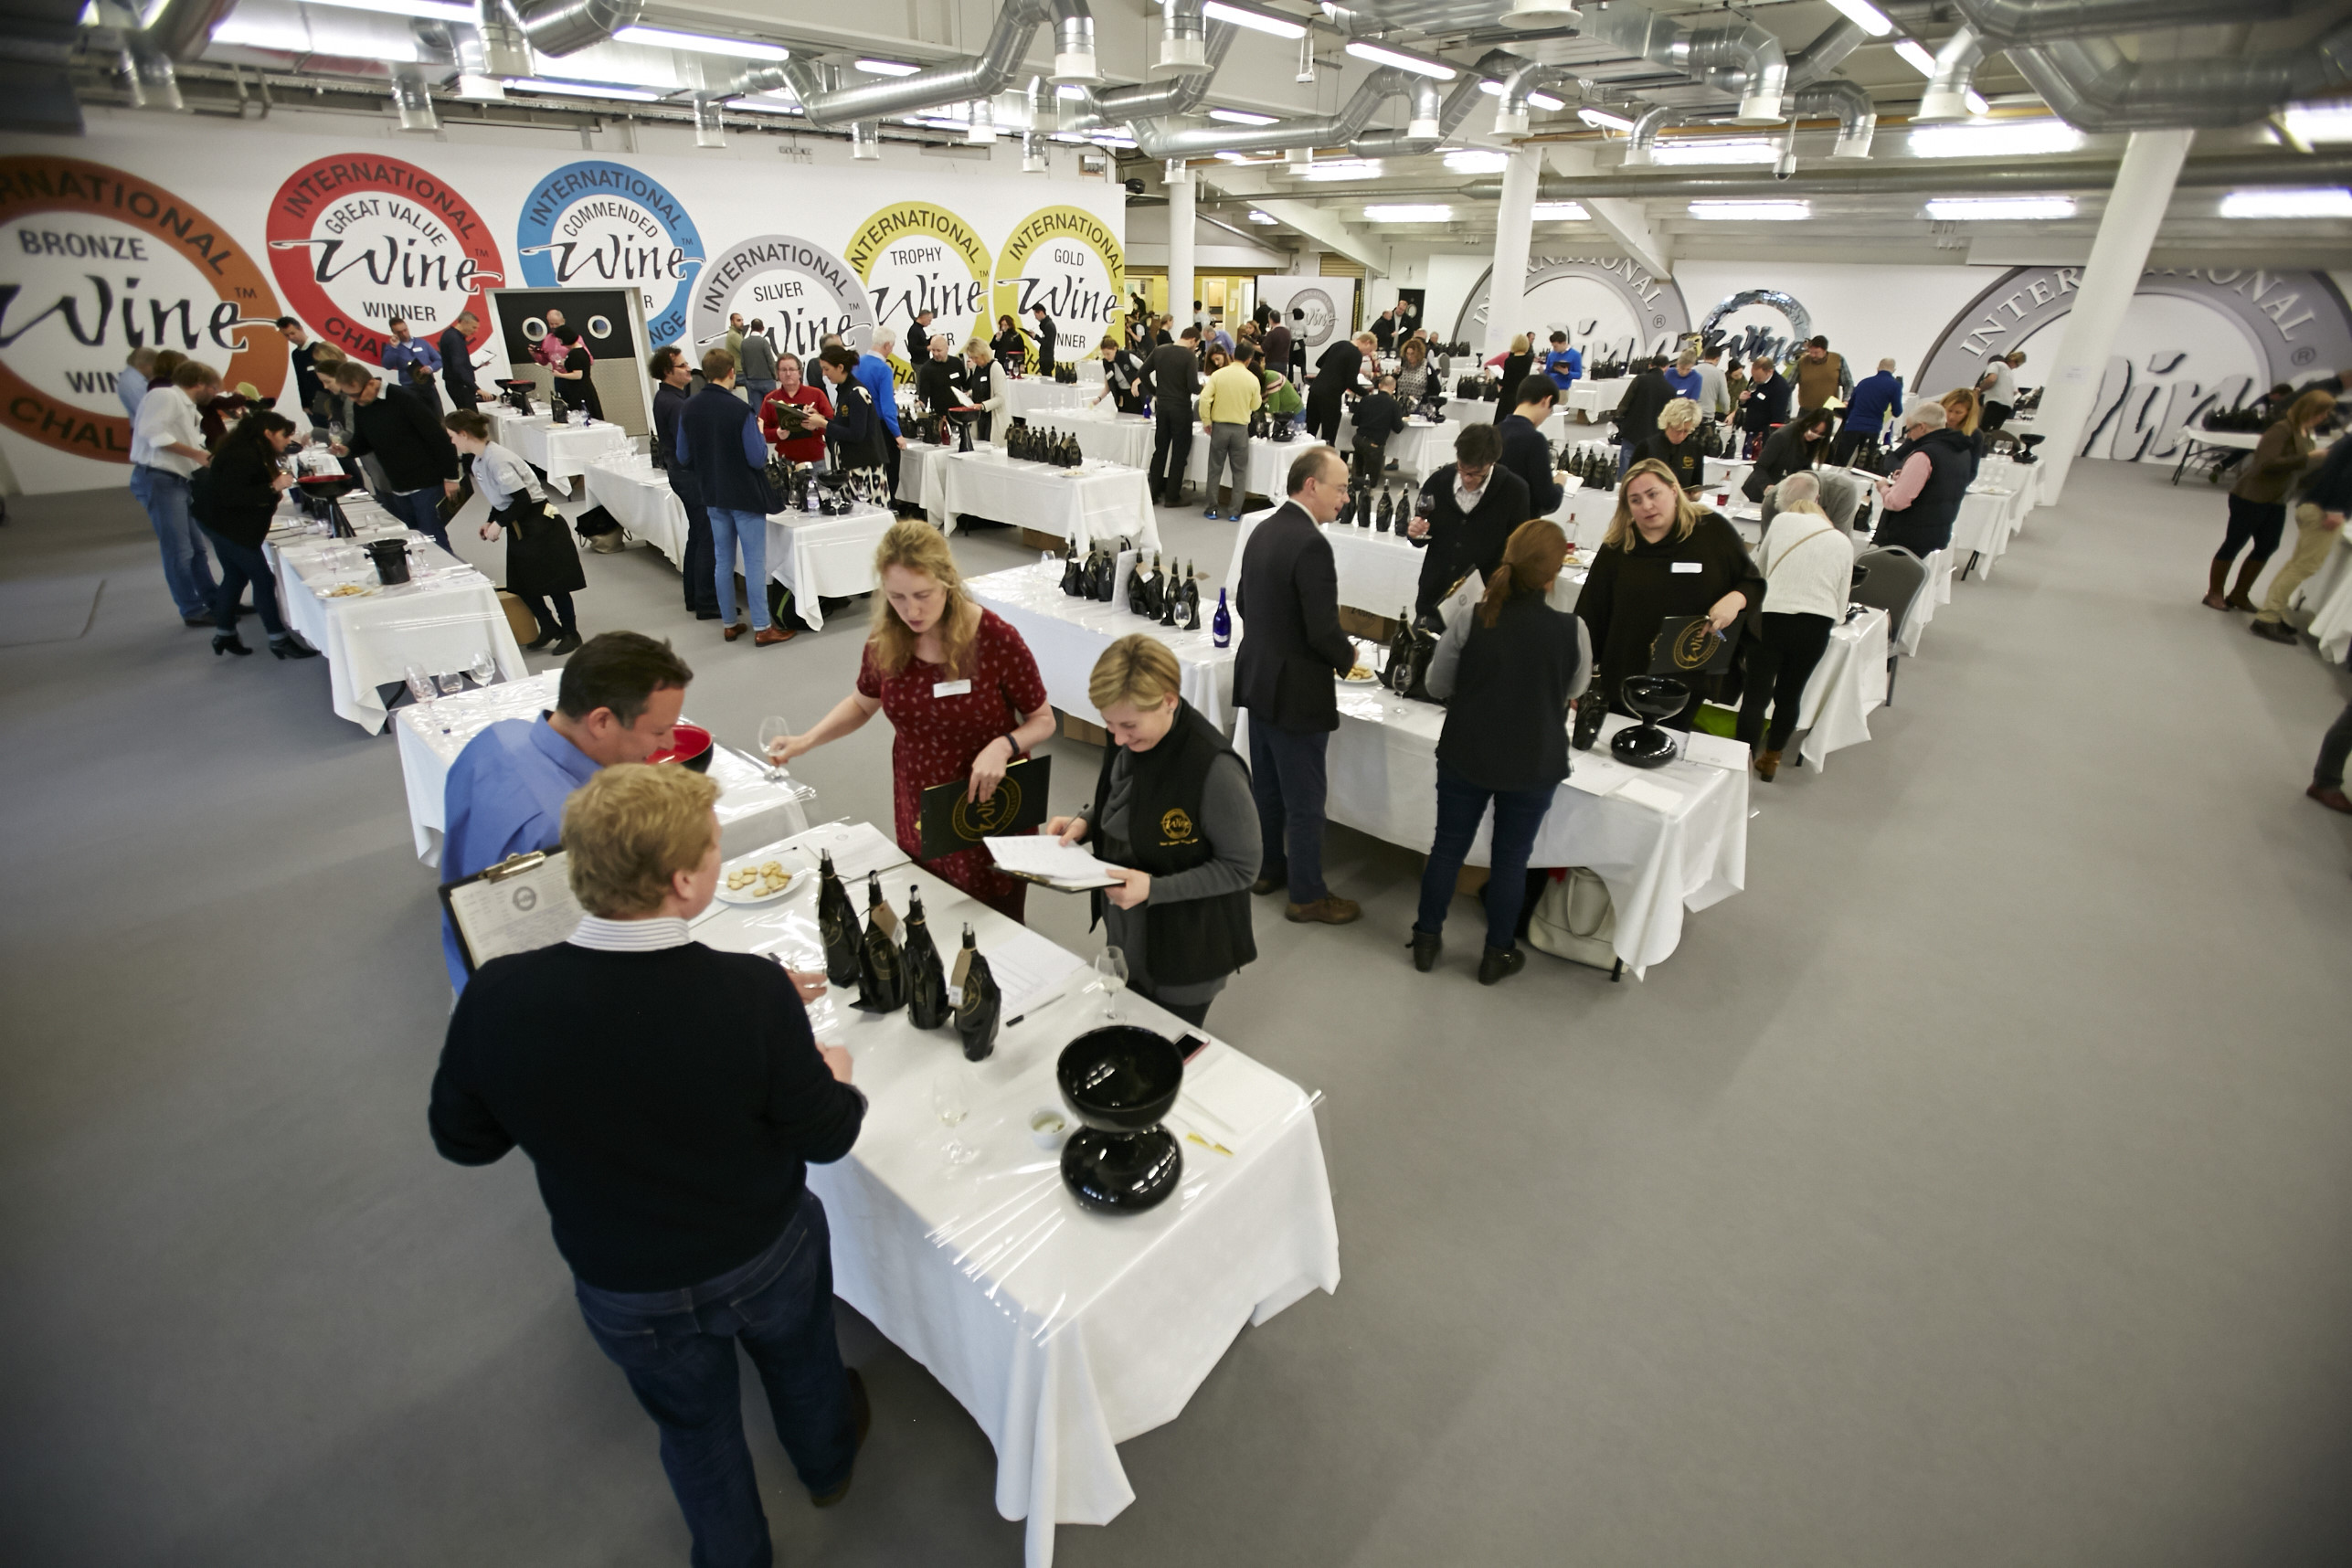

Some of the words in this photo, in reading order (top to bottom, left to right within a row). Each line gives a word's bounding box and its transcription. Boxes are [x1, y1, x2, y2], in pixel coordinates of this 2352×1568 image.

[283, 162, 476, 239] INTERNATIONAL
[529, 170, 683, 231] INTERNATIONAL
[325, 199, 380, 235] GREAT
[388, 201, 448, 247] VALUE
[564, 202, 658, 238] COMMENDED
[18, 229, 149, 261] BRONZE
[890, 247, 942, 266] TROPHY
[1009, 213, 1122, 279] INTERNATIONAL
[1054, 249, 1085, 267] GOLD
[703, 243, 848, 313] INTERNATIONAL
[754, 281, 804, 302] SILVER
[362, 302, 437, 322] WINNER
